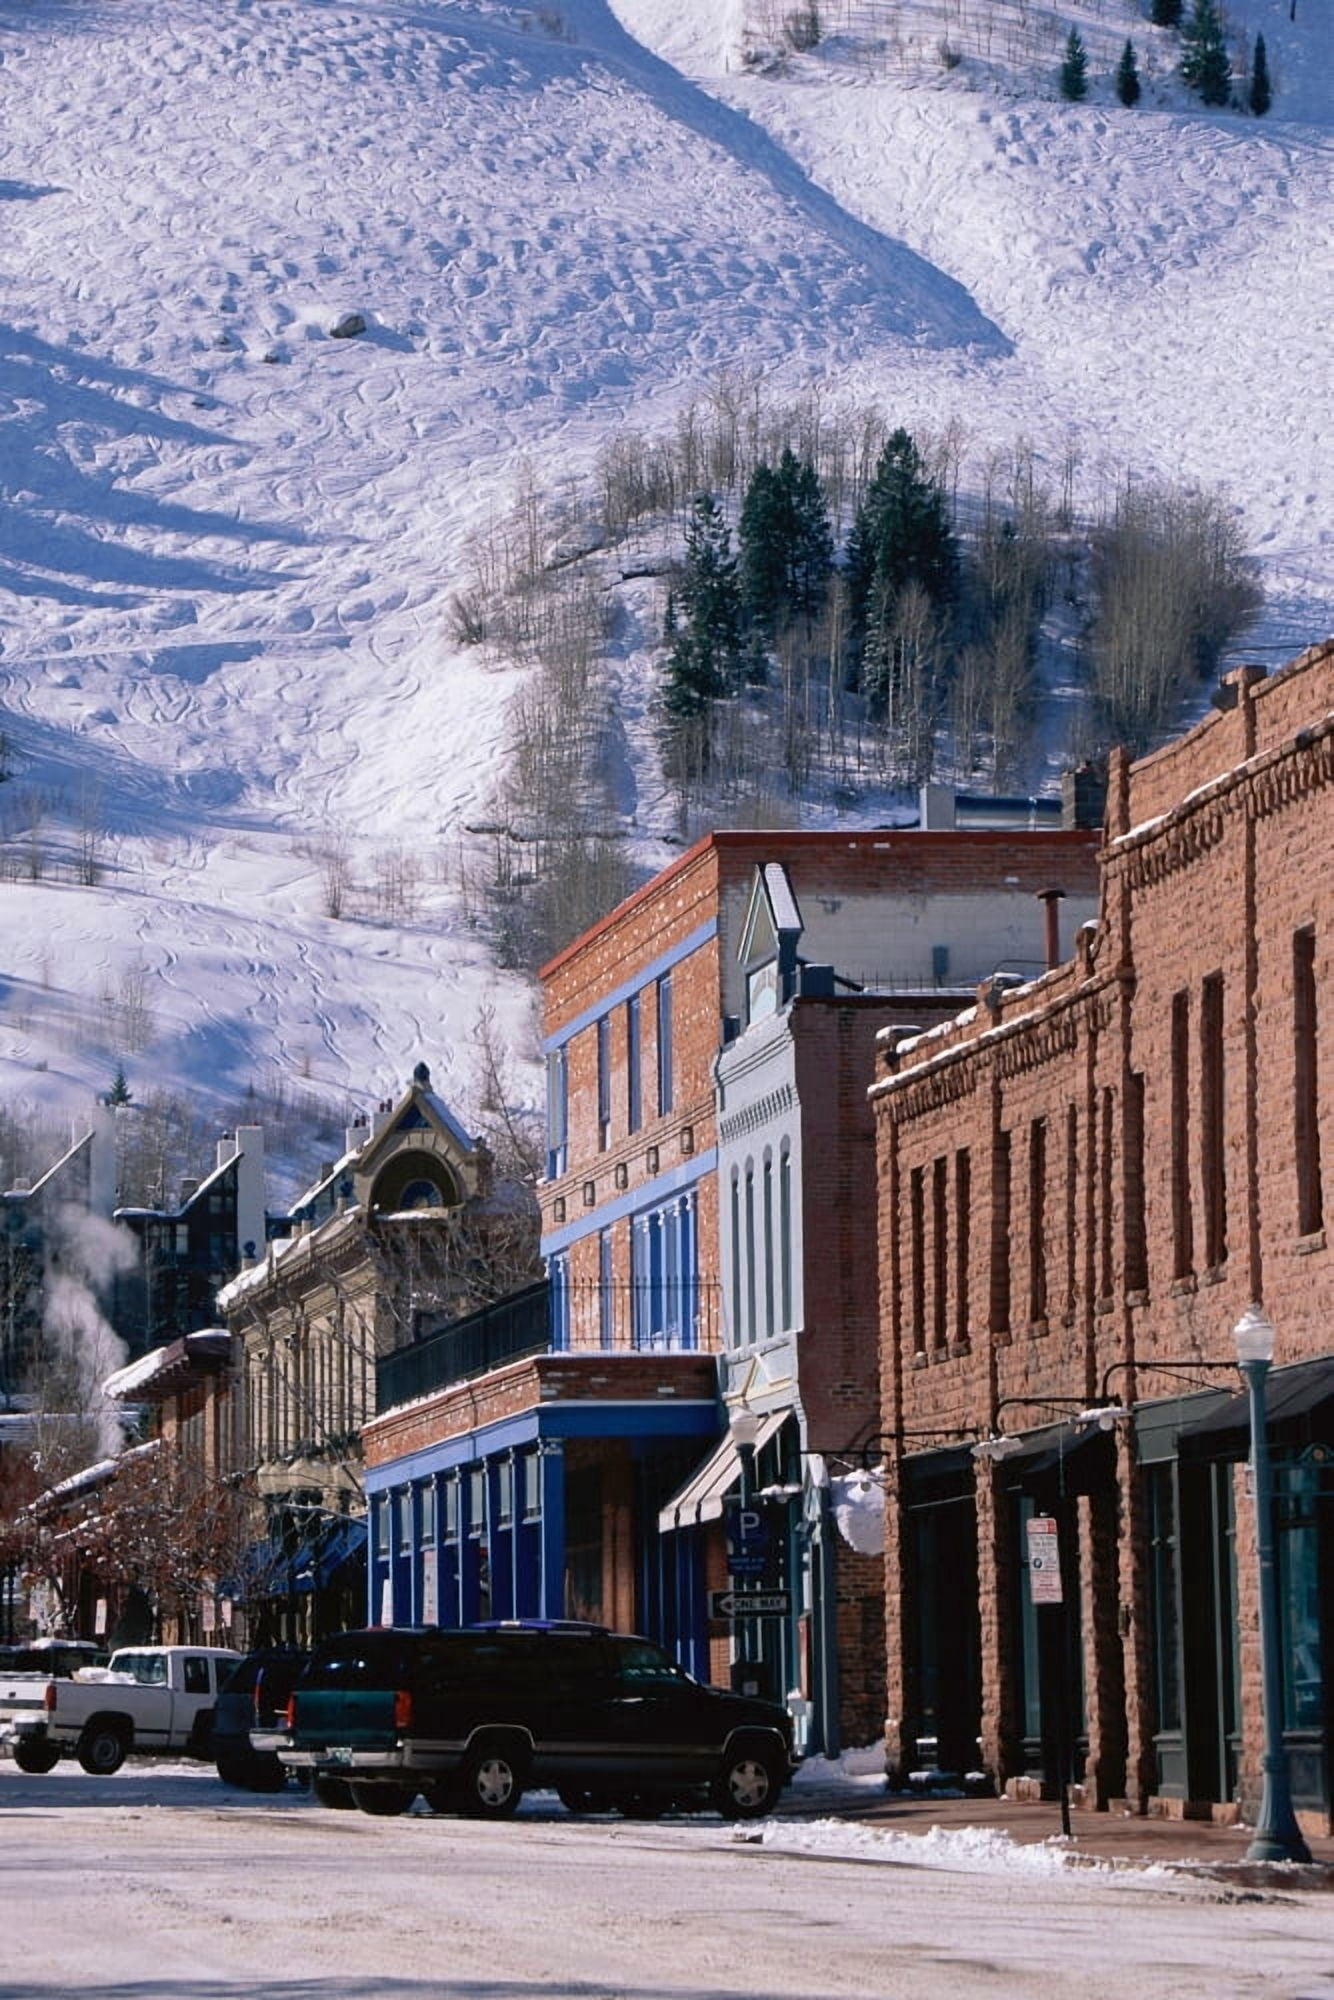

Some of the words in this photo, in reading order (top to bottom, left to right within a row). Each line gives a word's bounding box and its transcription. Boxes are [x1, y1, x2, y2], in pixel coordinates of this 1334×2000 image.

[740, 1512, 760, 1539] P
[735, 1599, 756, 1609] ONE
[760, 1599, 782, 1609] WAY
